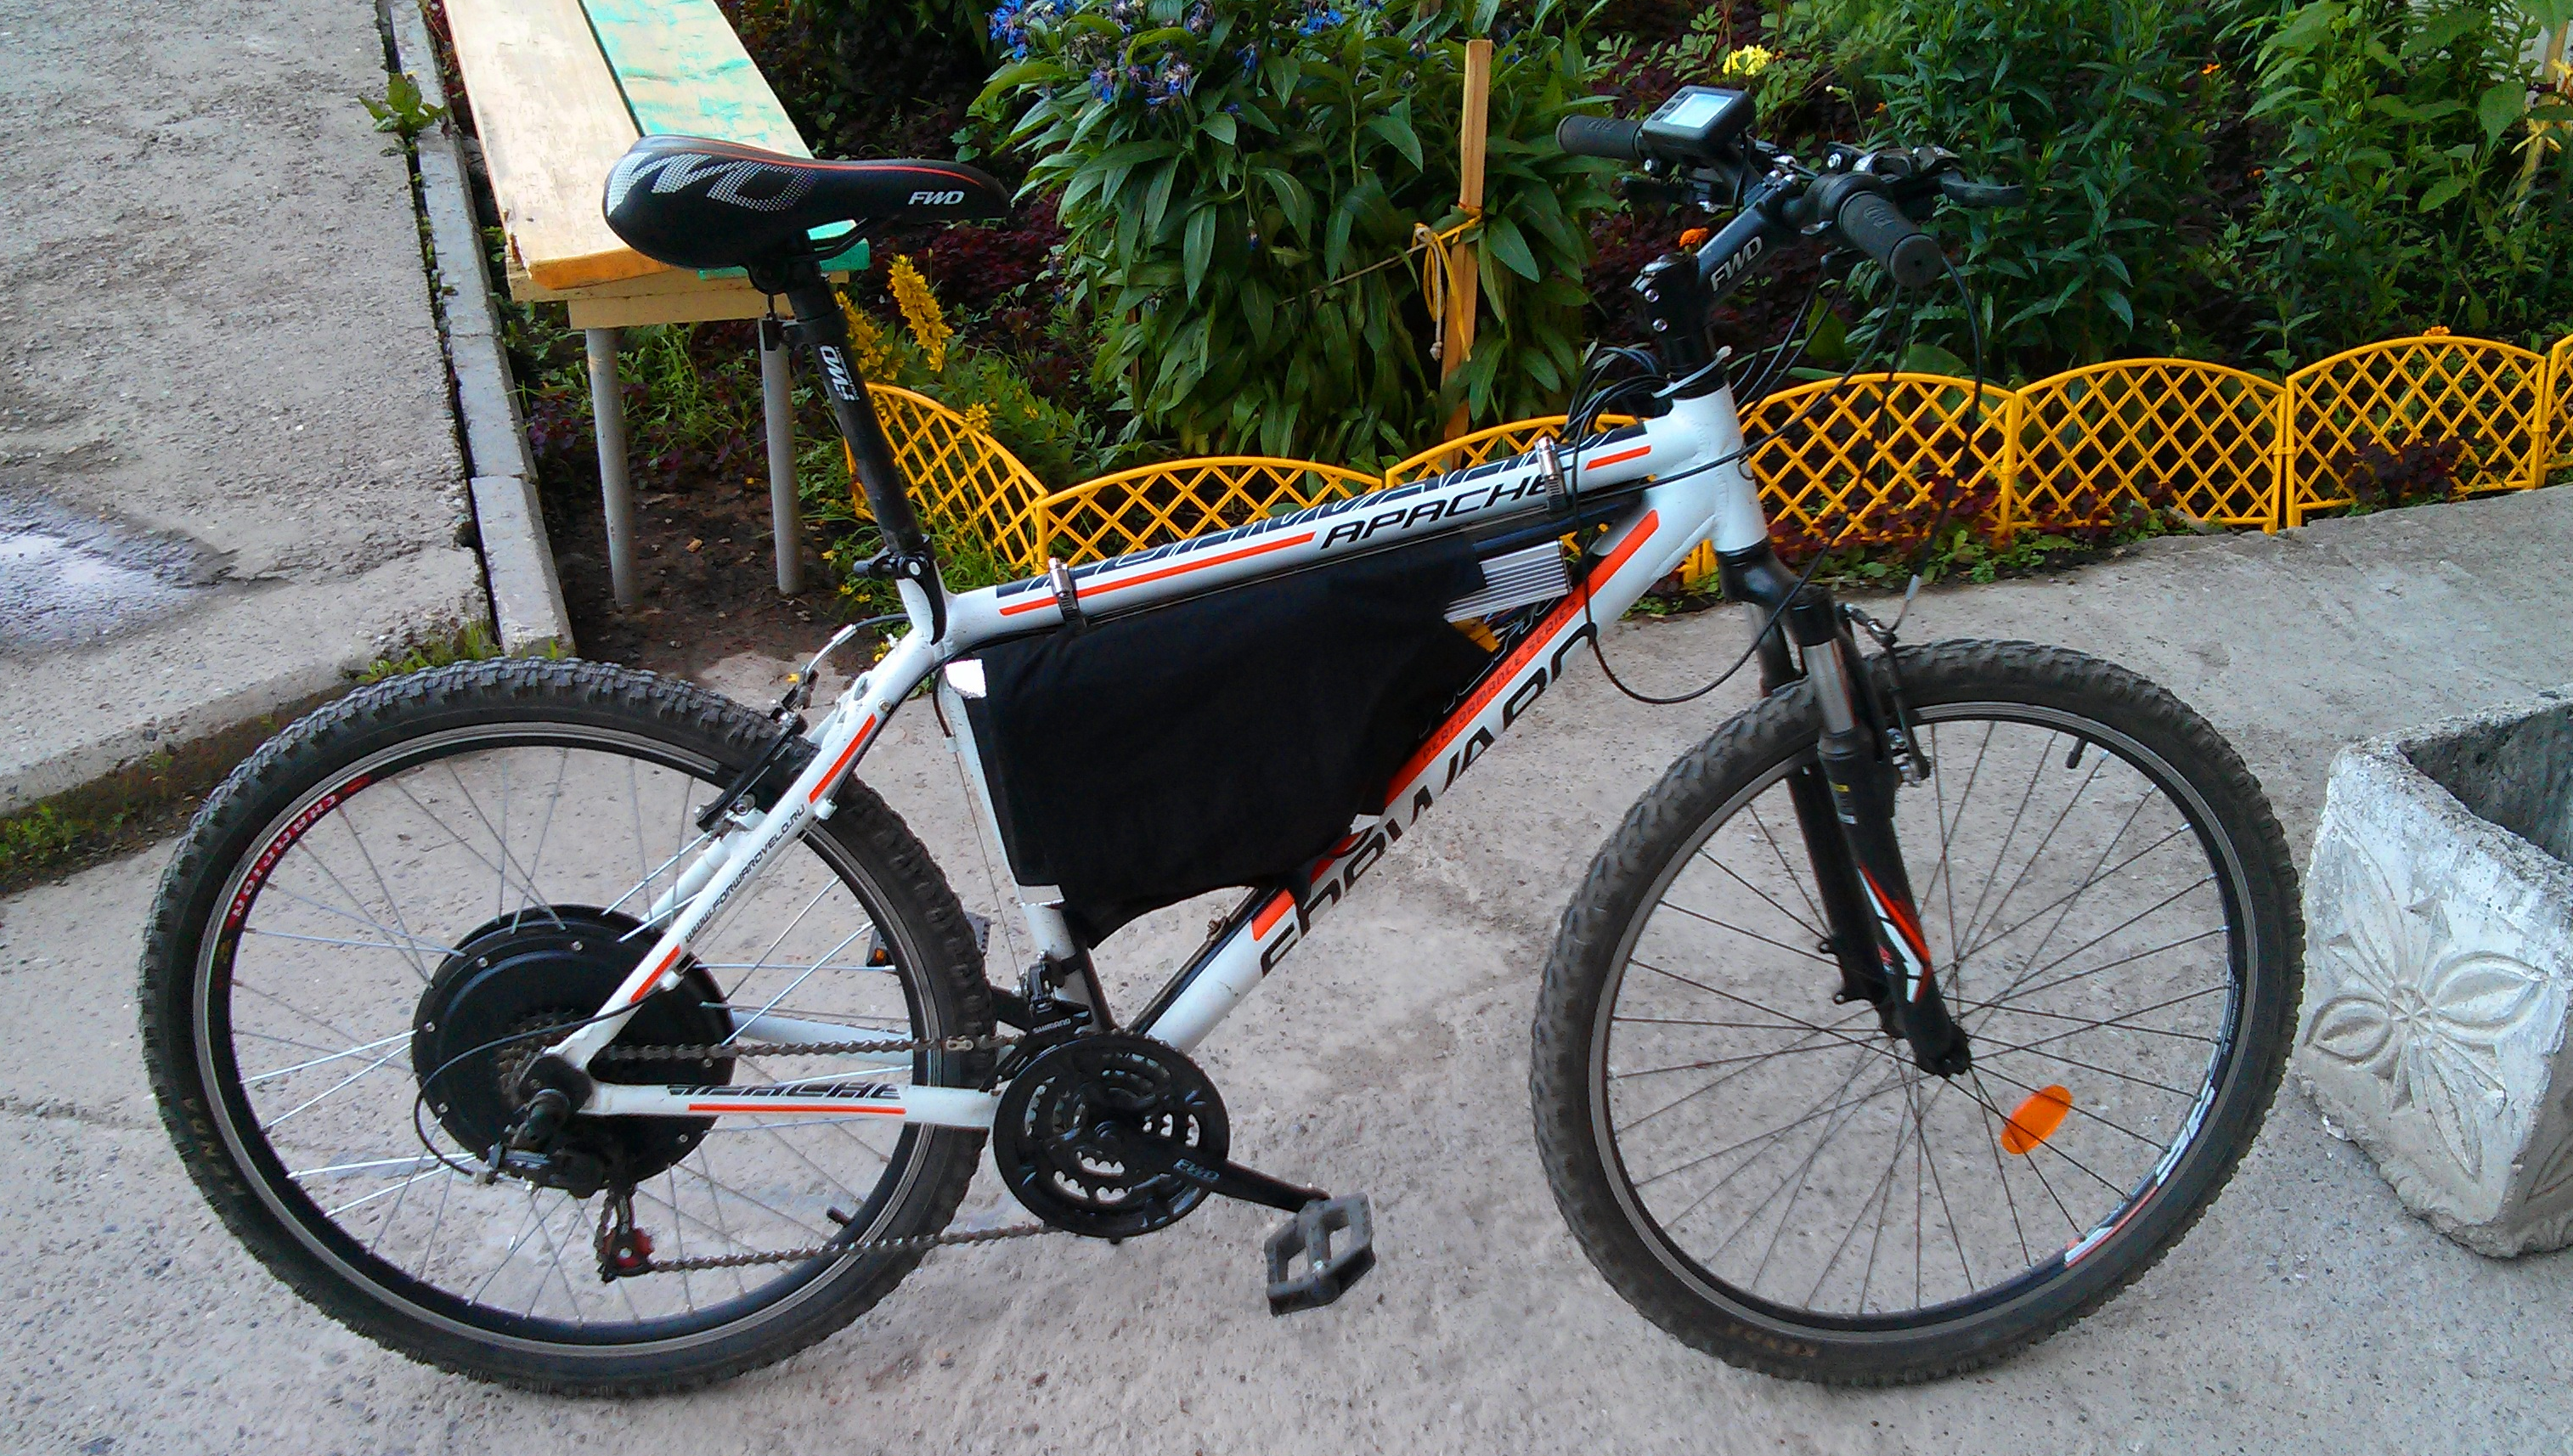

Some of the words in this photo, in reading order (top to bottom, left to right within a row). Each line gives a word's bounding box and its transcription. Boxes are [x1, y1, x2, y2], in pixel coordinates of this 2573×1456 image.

[907, 190, 965, 206] FWD
[1709, 235, 1763, 292] FWD
[1422, 656, 1522, 761] PERFORMANCE
[1526, 597, 1577, 652] SERIES
[1032, 1017, 1071, 1035] SHIMANO
